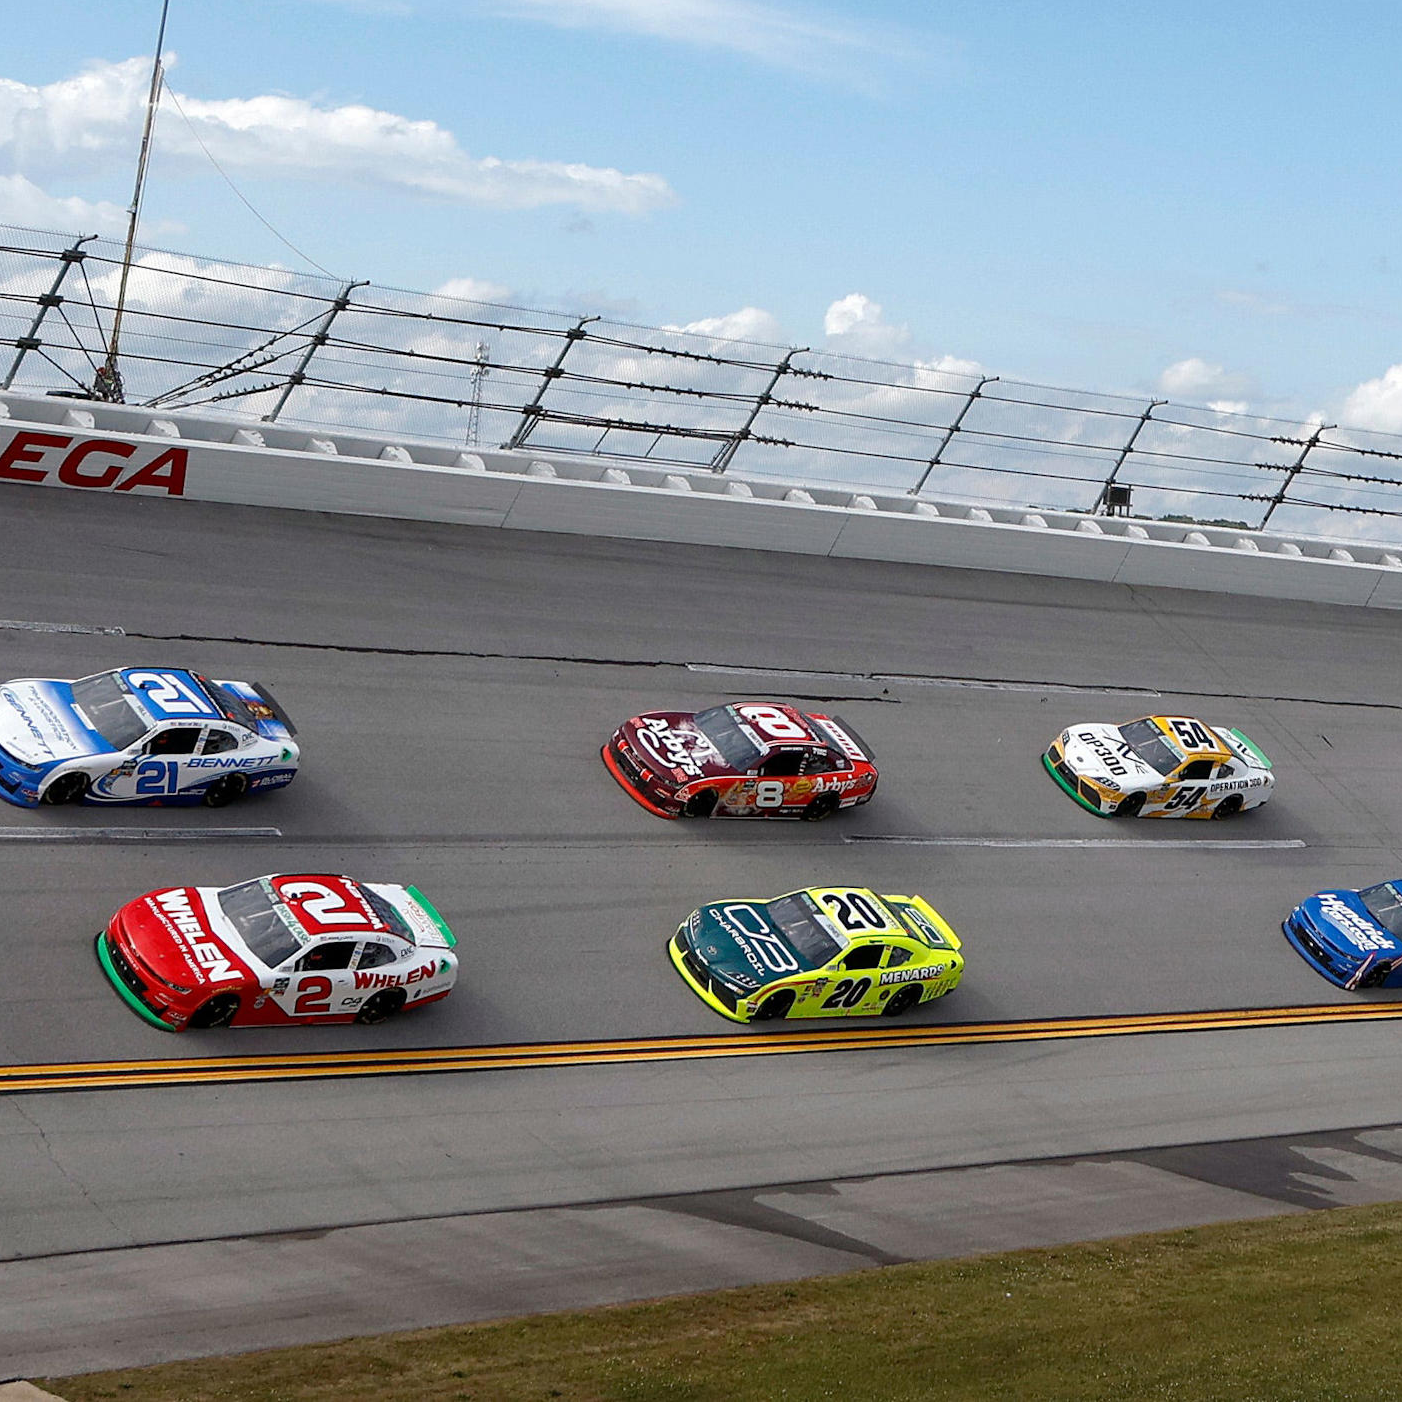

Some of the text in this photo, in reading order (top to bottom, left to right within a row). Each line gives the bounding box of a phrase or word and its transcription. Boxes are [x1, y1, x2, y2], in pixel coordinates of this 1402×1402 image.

[128, 672, 214, 714] 21
[3, 692, 56, 758] BENNETT
[740, 706, 807, 739] 8
[1170, 720, 1215, 749] 54
[187, 755, 279, 768] BENNETT
[1078, 732, 1128, 776] OP300
[135, 761, 179, 795] 21
[756, 780, 785, 808] 8
[811, 773, 857, 794] Arby's
[1210, 779, 1249, 792] OPERATION
[1163, 786, 1208, 810] 54
[280, 882, 369, 924] 2
[338, 878, 384, 930] WHELEN
[822, 892, 887, 930] 20
[144, 897, 206, 985] MANUFACTURED IN AMERICA
[155, 888, 244, 983] WHELEN
[709, 909, 766, 977] CHARBROIL
[353, 960, 436, 990] WHELEN
[820, 975, 873, 1010] 20
[880, 964, 945, 986] MENARDS
[294, 975, 333, 1014] 2
